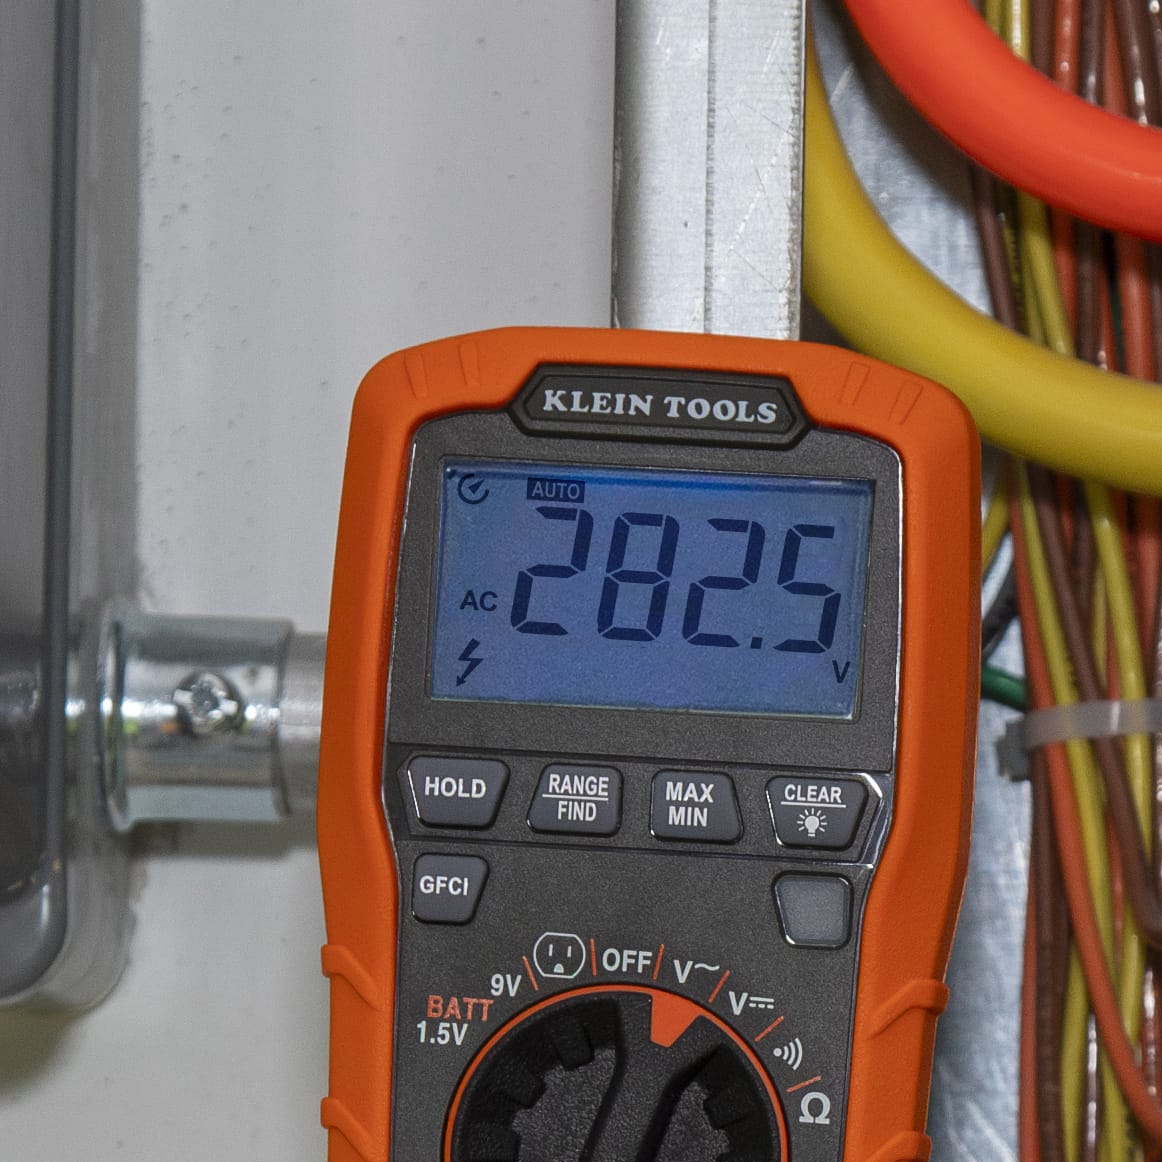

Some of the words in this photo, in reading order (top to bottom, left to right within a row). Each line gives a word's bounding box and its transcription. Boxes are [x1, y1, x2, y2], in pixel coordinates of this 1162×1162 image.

[542, 389, 653, 419] KLEIN
[664, 395, 778, 425] TOOLS
[531, 480, 582, 501] AUTO
[509, 505, 842, 654] 282.5
[460, 590, 498, 613] AC
[831, 660, 851, 684] V
[424, 775, 487, 799] HOLD
[547, 774, 609, 796] RANGE
[665, 782, 714, 804] MAX
[784, 784, 843, 803] CLEAR
[556, 800, 598, 822] FIND
[668, 806, 708, 828] MIN
[419, 875, 469, 897] GFCI
[601, 948, 652, 974] OFF
[489, 974, 521, 997] 9V
[426, 996, 494, 1021] BATT
[415, 1020, 468, 1046] 1.5V
